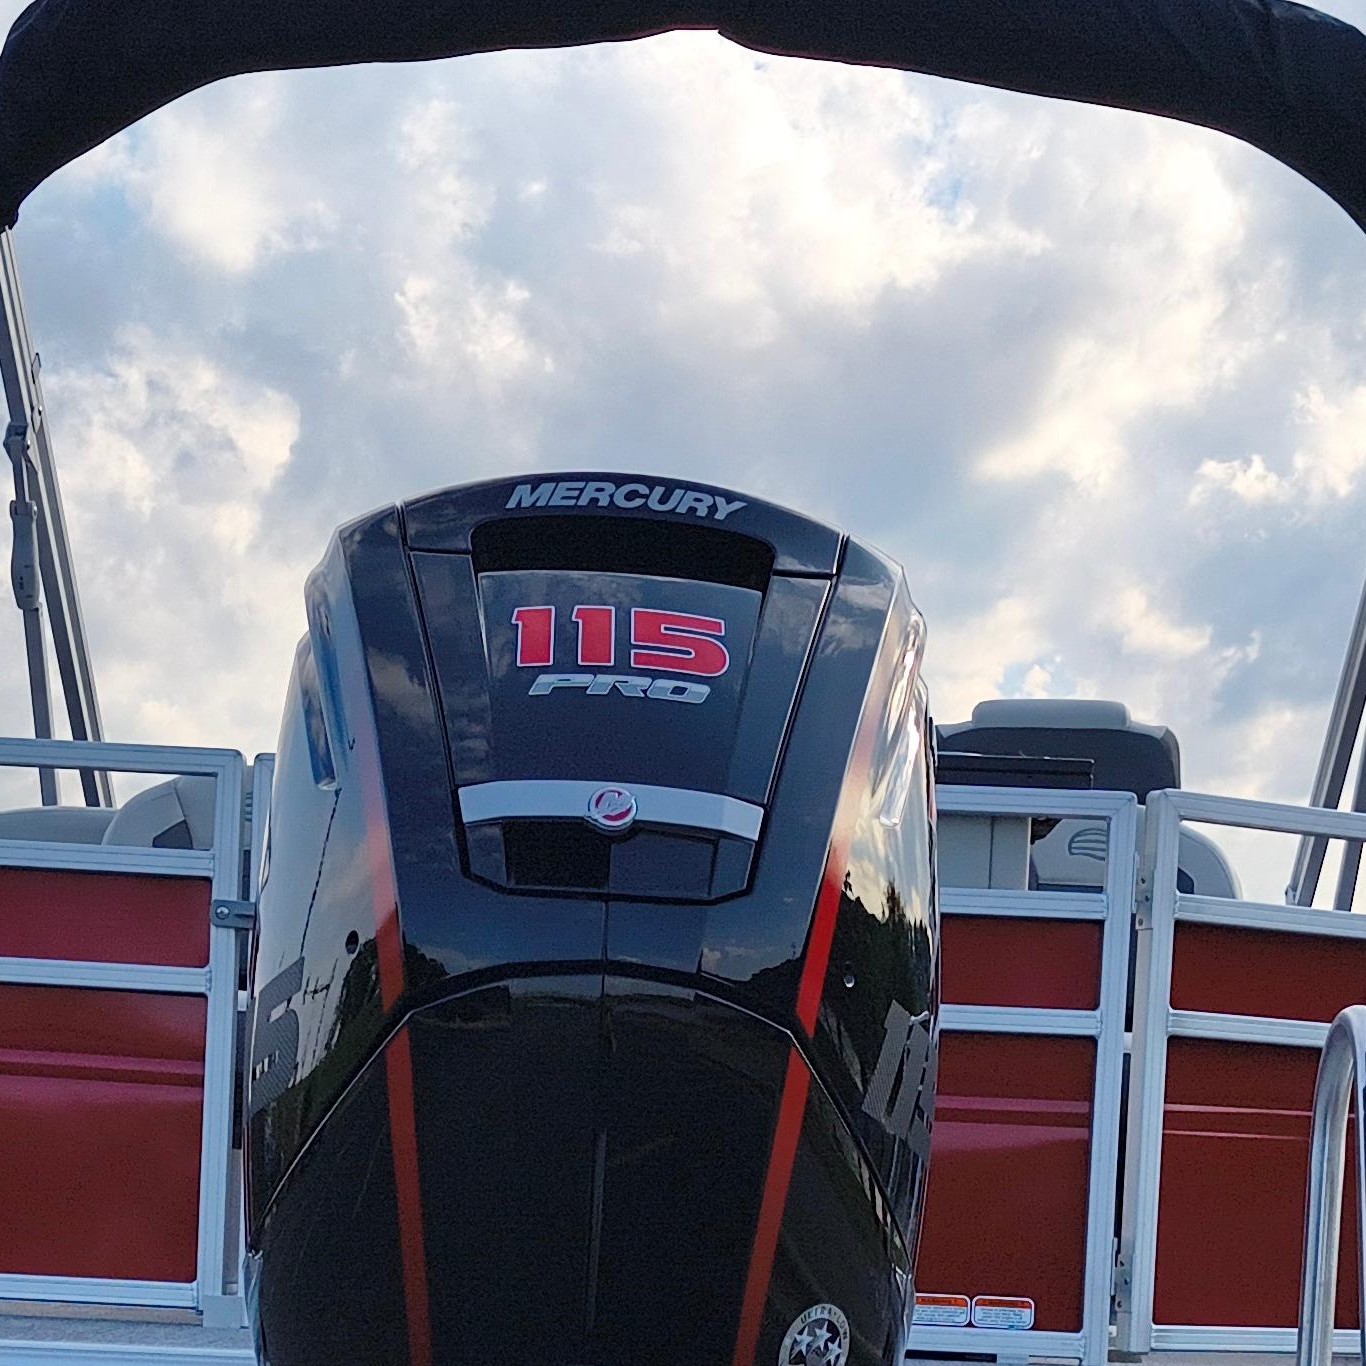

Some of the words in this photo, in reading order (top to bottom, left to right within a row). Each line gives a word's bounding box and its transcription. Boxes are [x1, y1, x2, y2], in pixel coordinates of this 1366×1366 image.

[505, 480, 748, 521] MERCURY
[511, 605, 730, 677] 115
[528, 673, 711, 704] PRO
